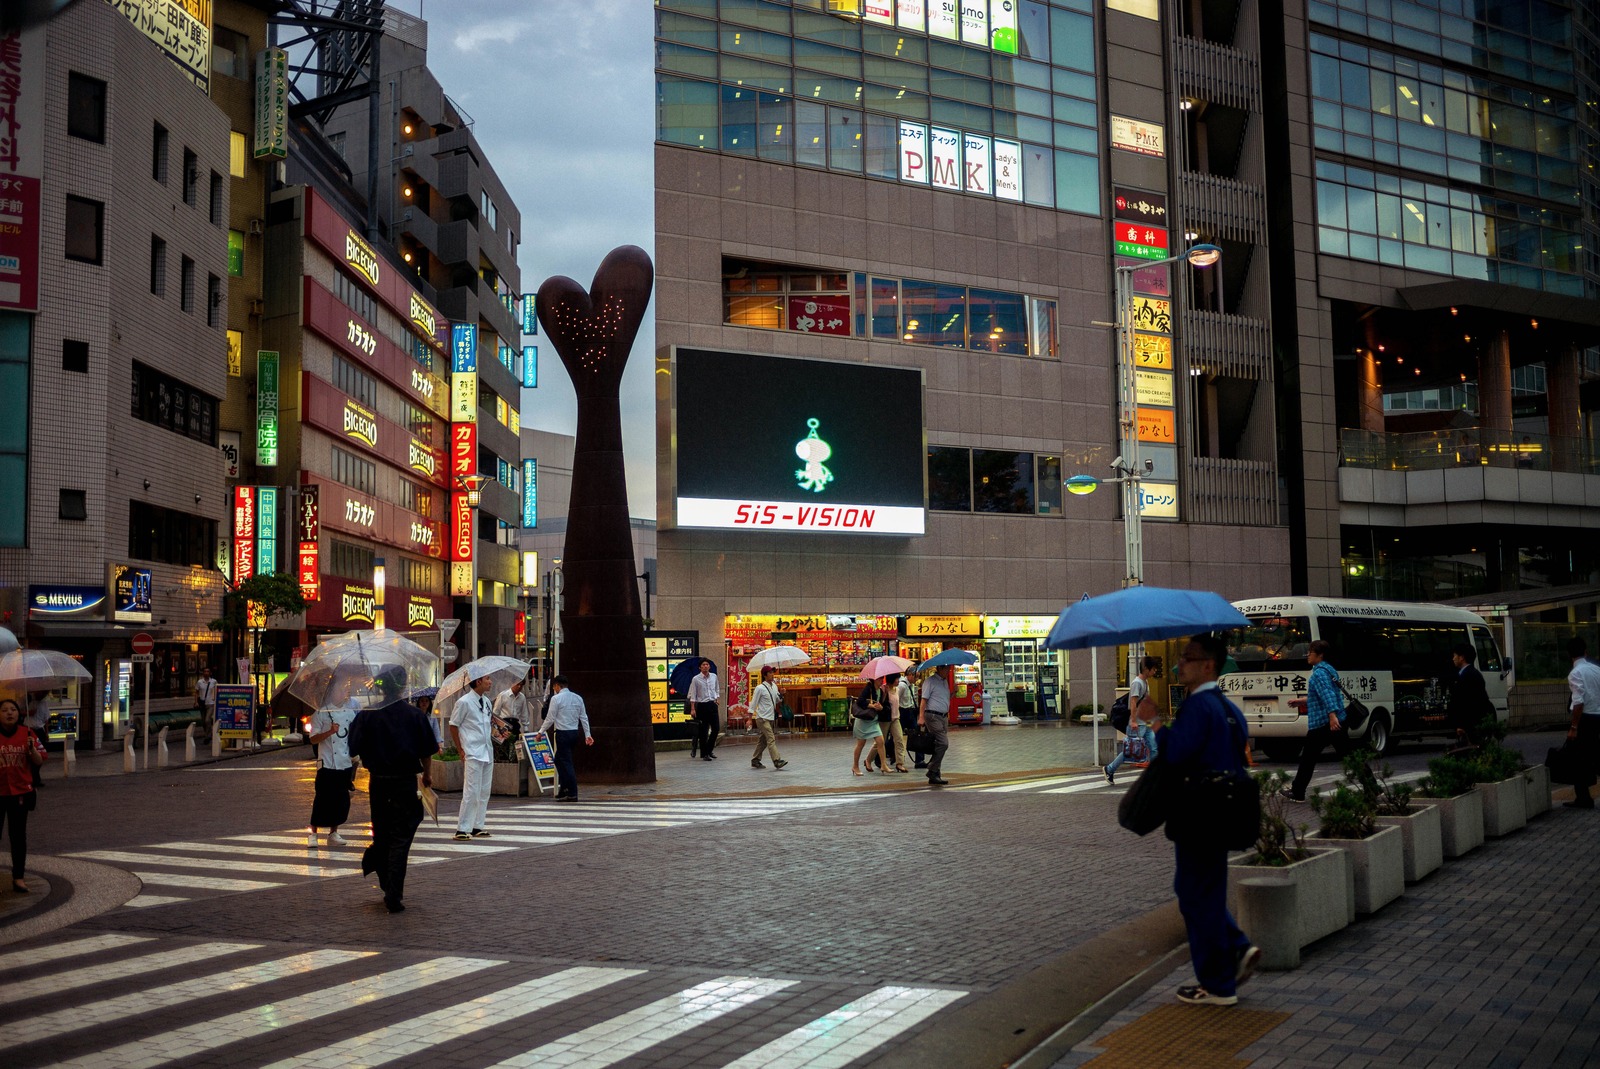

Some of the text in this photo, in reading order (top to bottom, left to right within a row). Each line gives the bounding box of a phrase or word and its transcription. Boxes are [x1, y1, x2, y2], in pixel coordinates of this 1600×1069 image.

[167, 3, 208, 50] 田町館にて
[1136, 132, 1159, 147] PMK
[995, 153, 1017, 165] Lady's
[1002, 166, 1010, 177] &
[996, 179, 1017, 190] Men's
[1138, 200, 1165, 215] やまや
[1127, 227, 1156, 245] 歯科
[1118, 244, 1149, 256] アキラ歯科
[346, 235, 379, 285] BIG ECHO
[1153, 277, 1165, 290] 林
[1156, 300, 1168, 309] 2F
[410, 297, 436, 336] BIG ECHO
[795, 314, 843, 333] やまや
[347, 320, 376, 356] カラオケ
[1134, 337, 1158, 347] カレー
[411, 369, 433, 398] カラオケ
[258, 390, 277, 448] 接骨院
[343, 406, 377, 447] BIG ECHO
[1138, 424, 1170, 437] かなし
[409, 443, 435, 476] BIG ECHO
[458, 495, 470, 521] BIG
[1146, 494, 1175, 505] ローソン
[262, 493, 272, 549] 中国語会話
[305, 494, 314, 540] DALI
[345, 499, 375, 527] カラオケ
[410, 522, 432, 546] カラオケ
[458, 524, 471, 558] ECHO
[49, 594, 83, 605] MEVIUS
[342, 593, 358, 617] BIG
[358, 596, 375, 621] ECHO
[1238, 603, 1294, 612] 3-3471-4531
[408, 603, 434, 623] BIG ECHO
[1318, 604, 1406, 617] http://www.nakakin.com
[775, 616, 826, 631] わかなし
[876, 616, 897, 631] ¥330
[917, 622, 969, 634] わかなし
[670, 647, 692, 655] 心療内科
[1274, 675, 1307, 692] 中金
[1359, 675, 1378, 692] 中金
